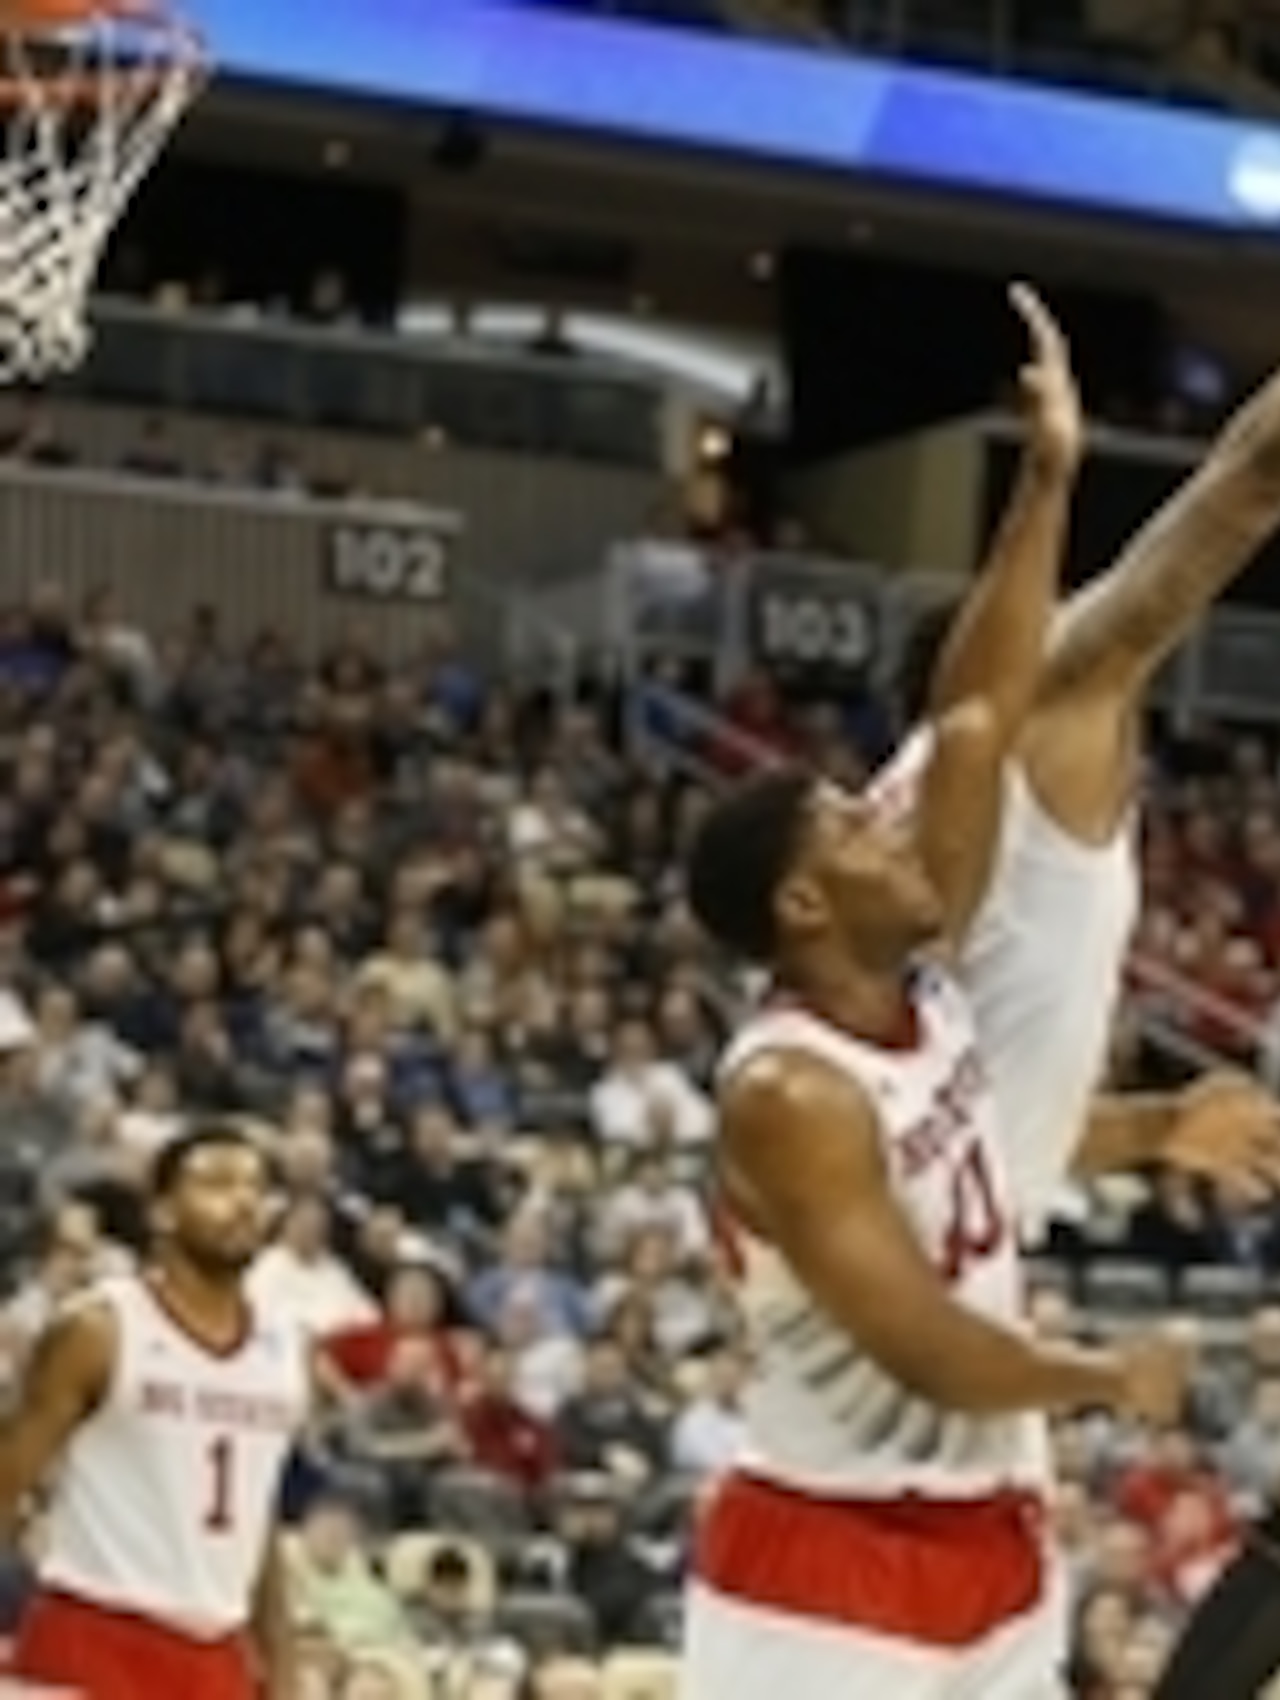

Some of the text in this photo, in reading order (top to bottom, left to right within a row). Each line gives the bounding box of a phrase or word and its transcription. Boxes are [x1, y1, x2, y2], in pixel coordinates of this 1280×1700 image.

[334, 529, 444, 596] 102
[764, 591, 868, 662] 103
[204, 1433, 234, 1531] 1
